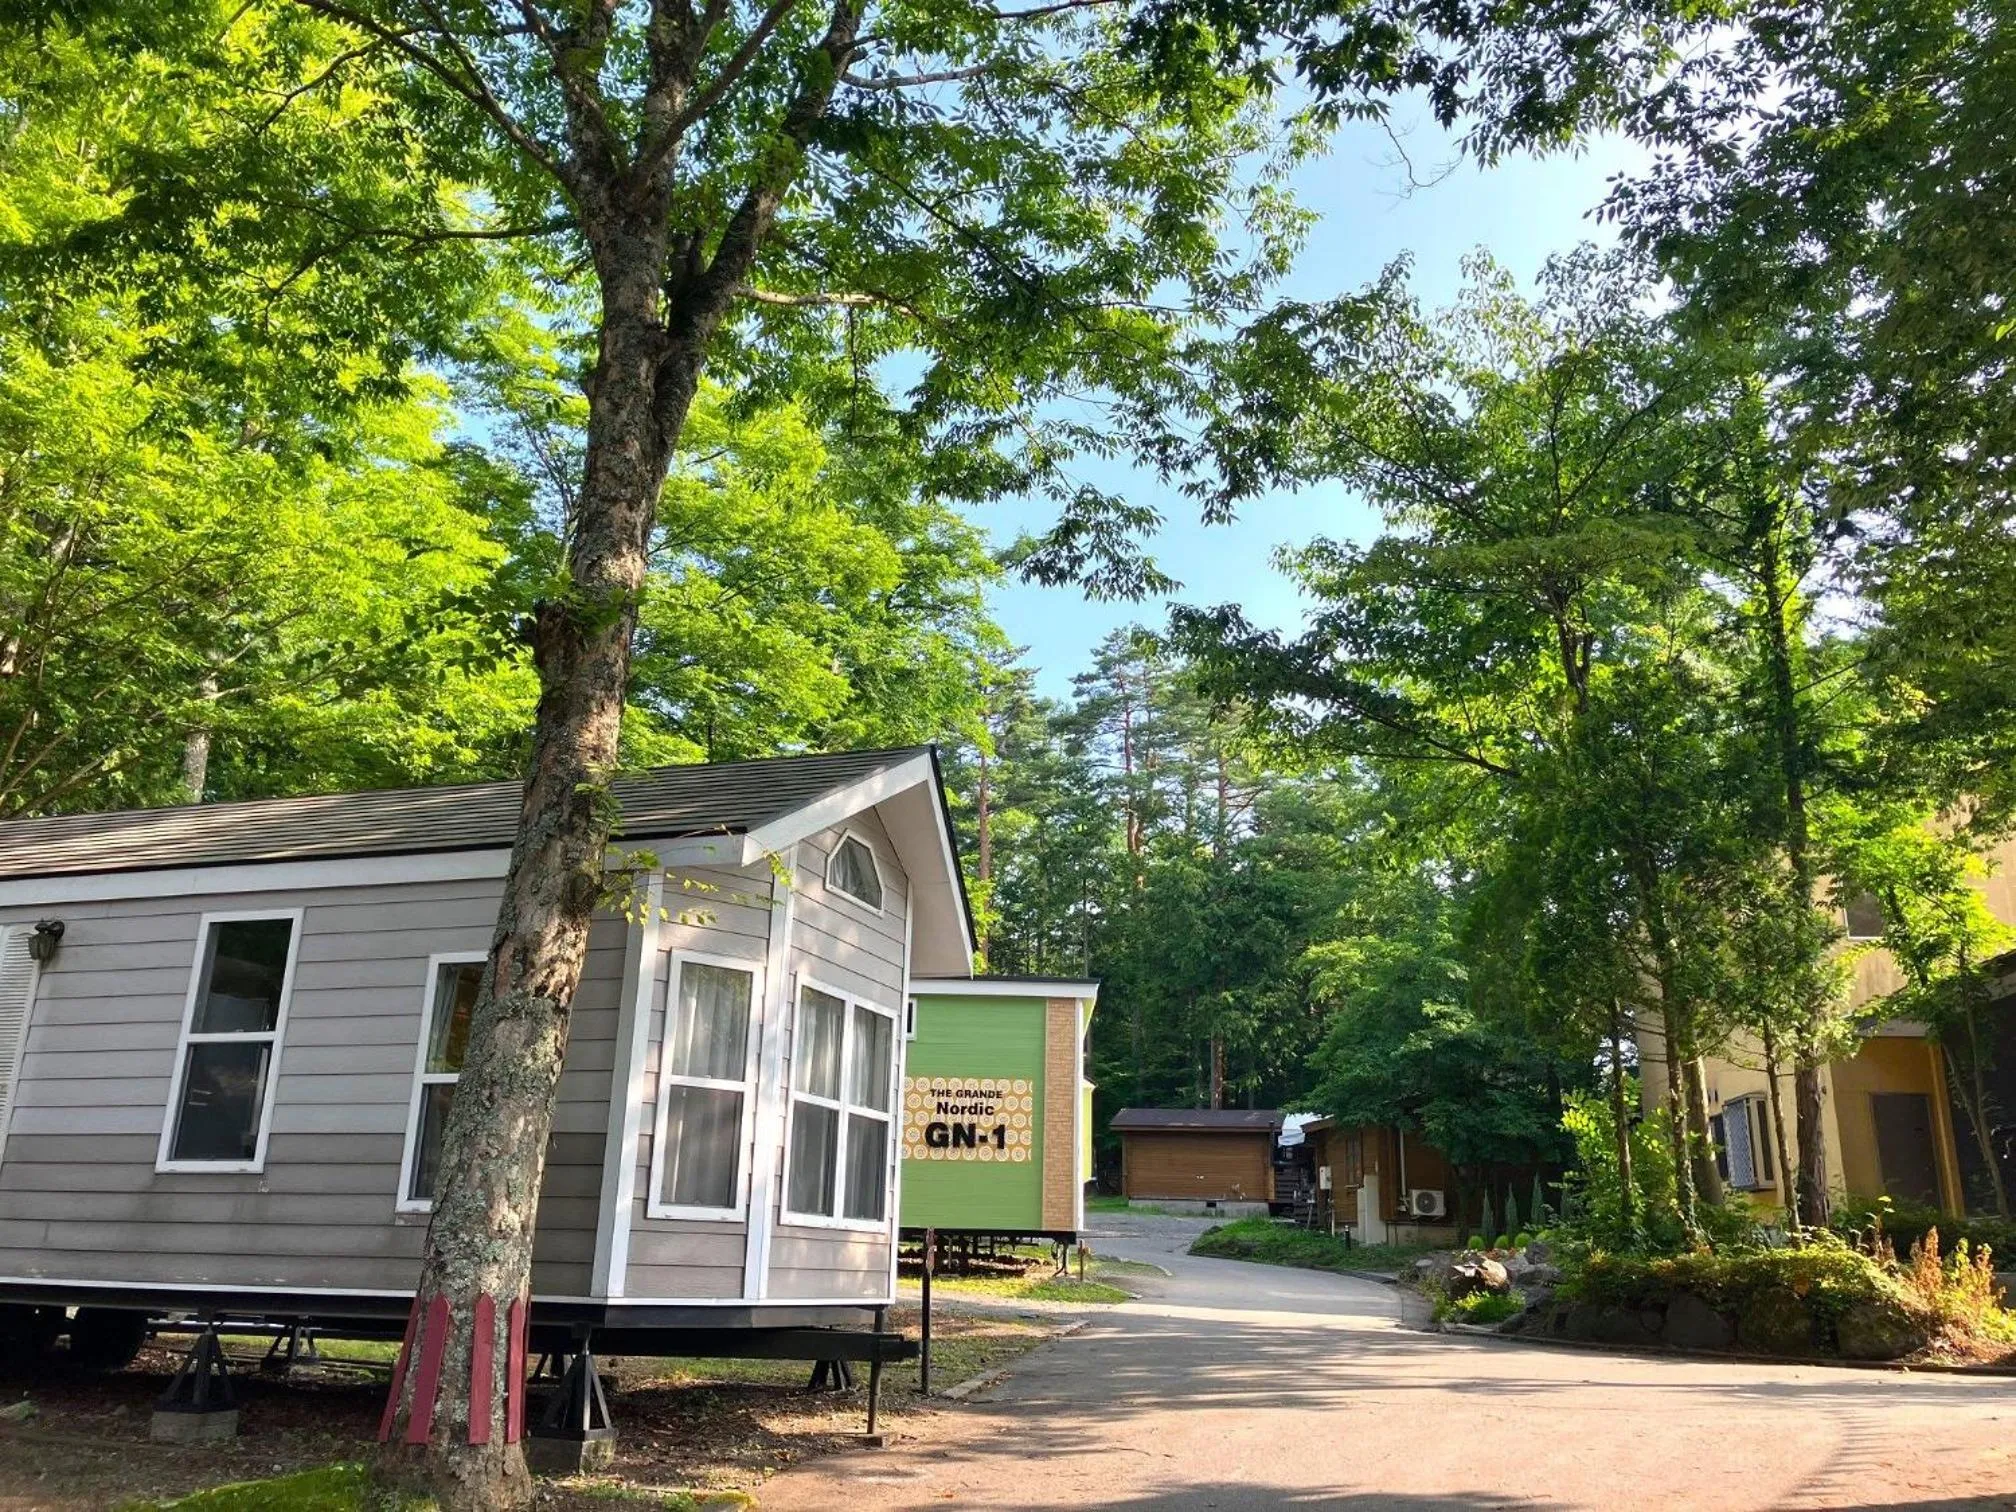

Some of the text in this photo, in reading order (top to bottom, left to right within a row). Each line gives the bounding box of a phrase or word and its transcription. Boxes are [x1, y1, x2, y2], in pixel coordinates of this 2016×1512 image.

[930, 1089, 1003, 1099] THE GRANDE
[936, 1102, 994, 1116] Nordic
[925, 1122, 1005, 1149] GN-1
